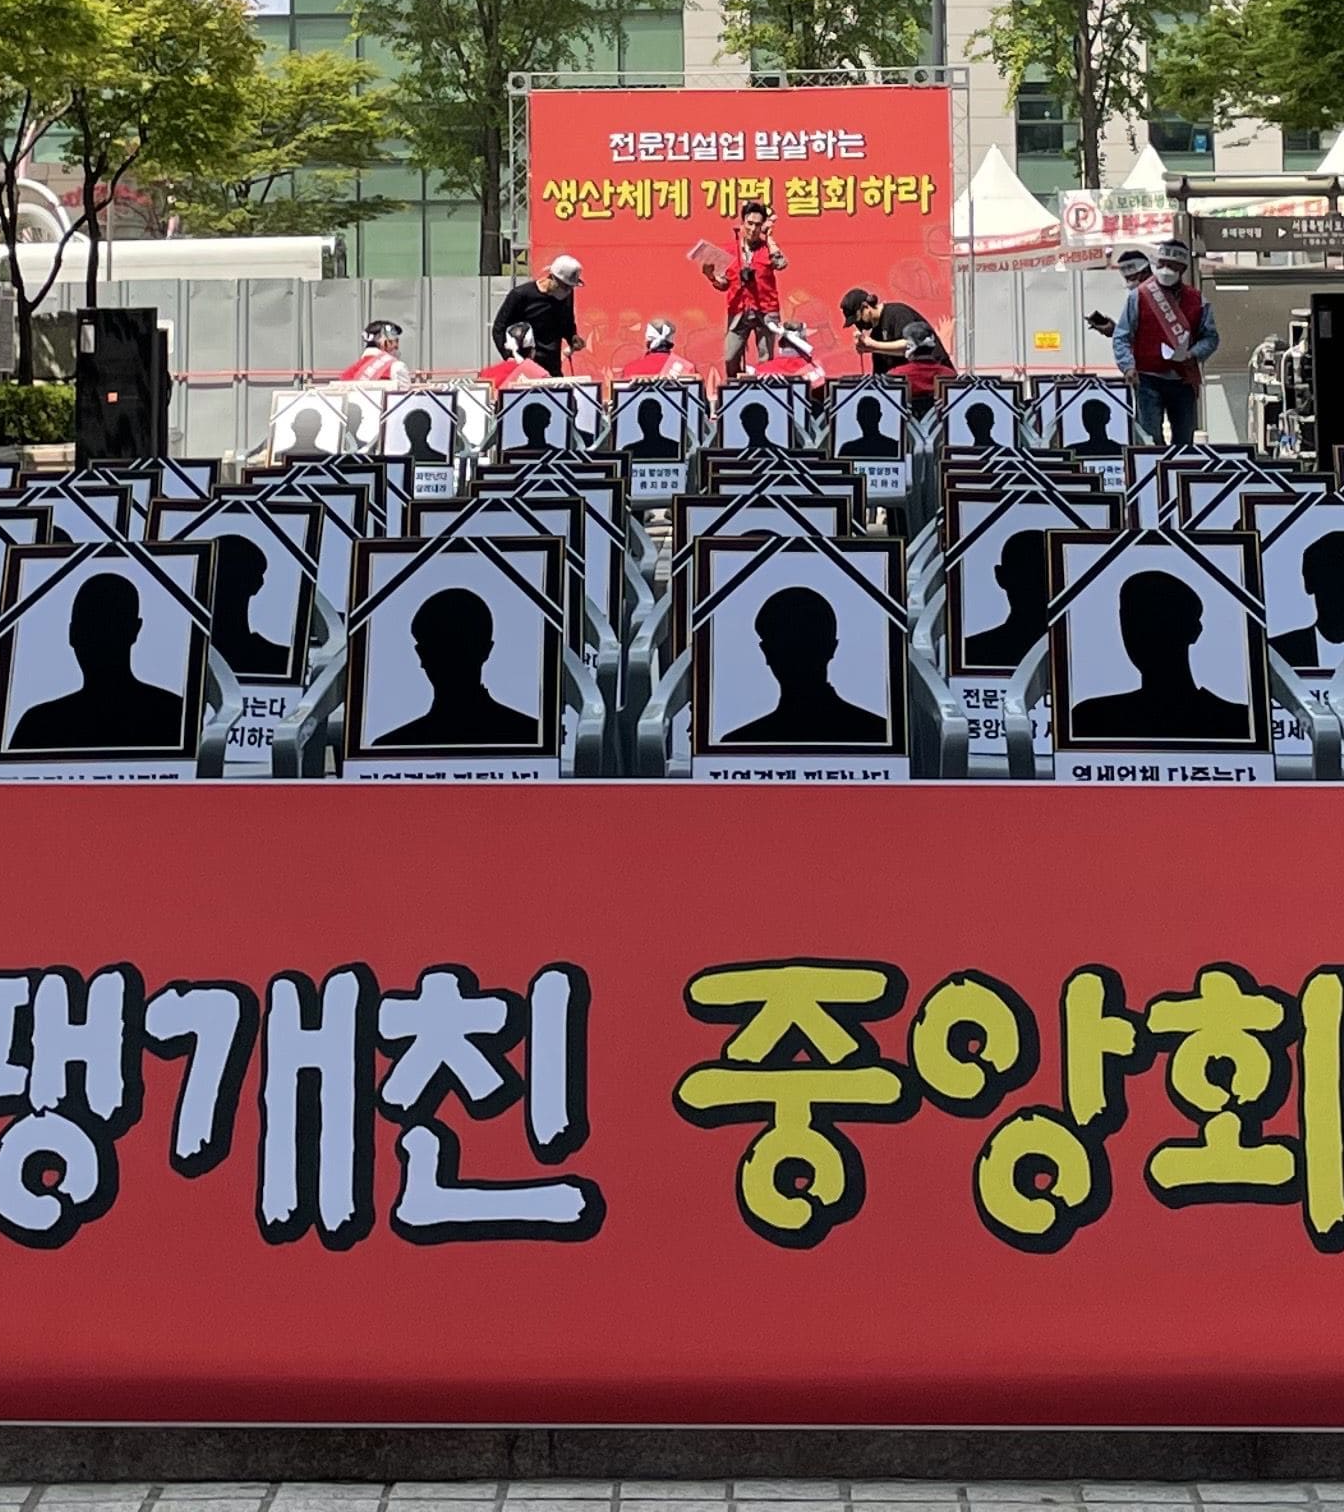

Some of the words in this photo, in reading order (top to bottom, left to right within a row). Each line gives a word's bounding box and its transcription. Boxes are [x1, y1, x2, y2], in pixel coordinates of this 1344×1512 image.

[608, 131, 745, 163] 전문건설업
[755, 129, 867, 161] 말살하는
[542, 177, 690, 220] 생산체계
